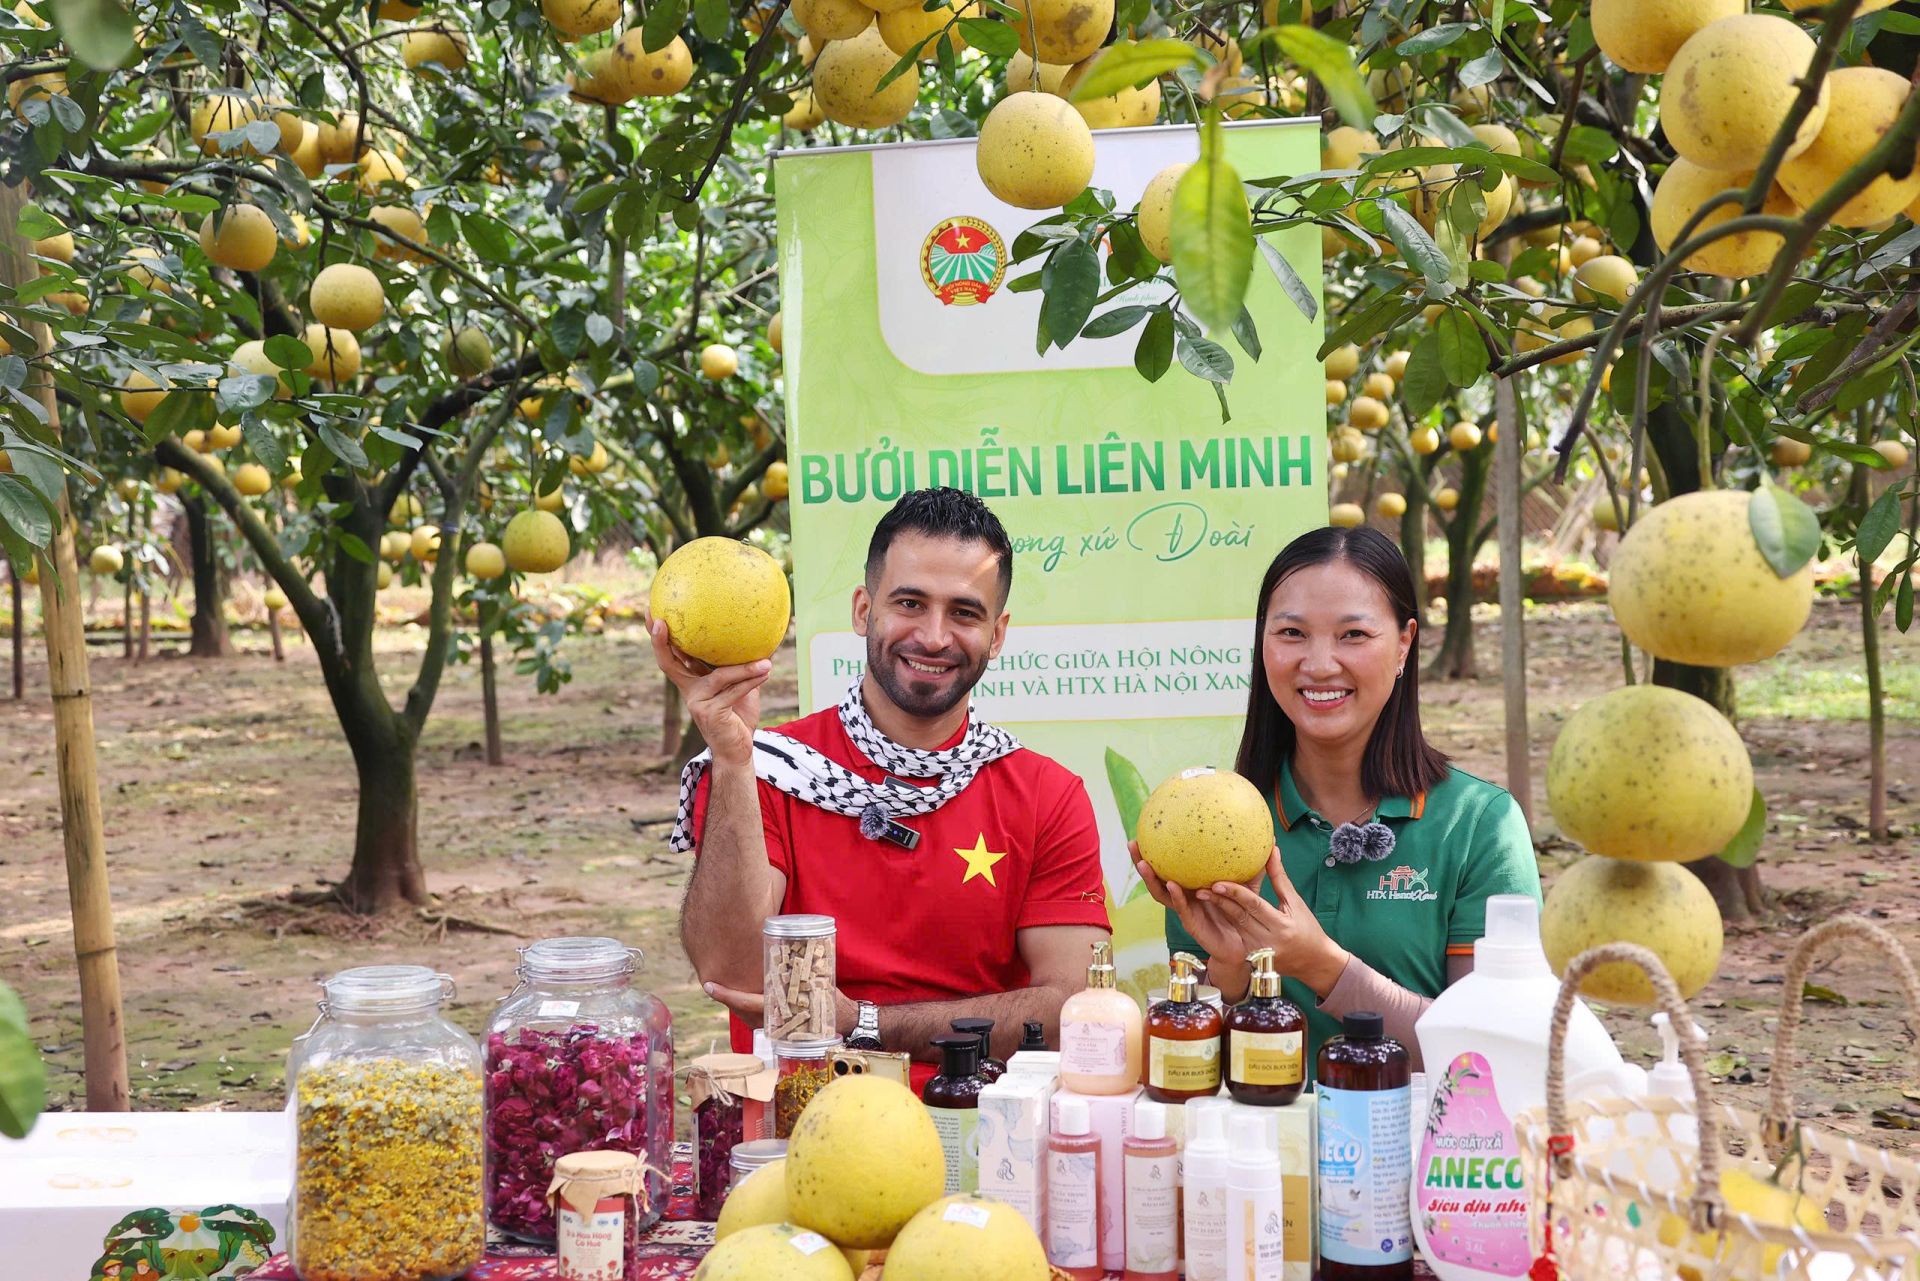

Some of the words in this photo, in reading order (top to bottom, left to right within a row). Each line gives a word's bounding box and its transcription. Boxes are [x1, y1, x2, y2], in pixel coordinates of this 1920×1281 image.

[801, 437, 916, 504] BƯỞI
[929, 427, 1042, 498] DIỄN
[1056, 431, 1164, 494] LIÊN
[1181, 434, 1312, 490] MINH
[1080, 526, 1120, 557] xứ
[1126, 502, 1255, 562] Đoài
[1054, 648, 1110, 670] GIỮA
[1117, 646, 1161, 671] HỘI
[1169, 644, 1241, 666] NÔNG
[1021, 676, 1050, 696] VÀ
[1056, 676, 1106, 696] HTX
[1113, 672, 1147, 694] HÀ
[1154, 671, 1197, 695] NỘI
[1205, 672, 1252, 690] XAN
[1434, 1133, 1458, 1149] NƯỚC
[1459, 1133, 1483, 1152] GIẶT
[1485, 1130, 1503, 1150] XẢ
[1425, 1155, 1524, 1190] ANECO
